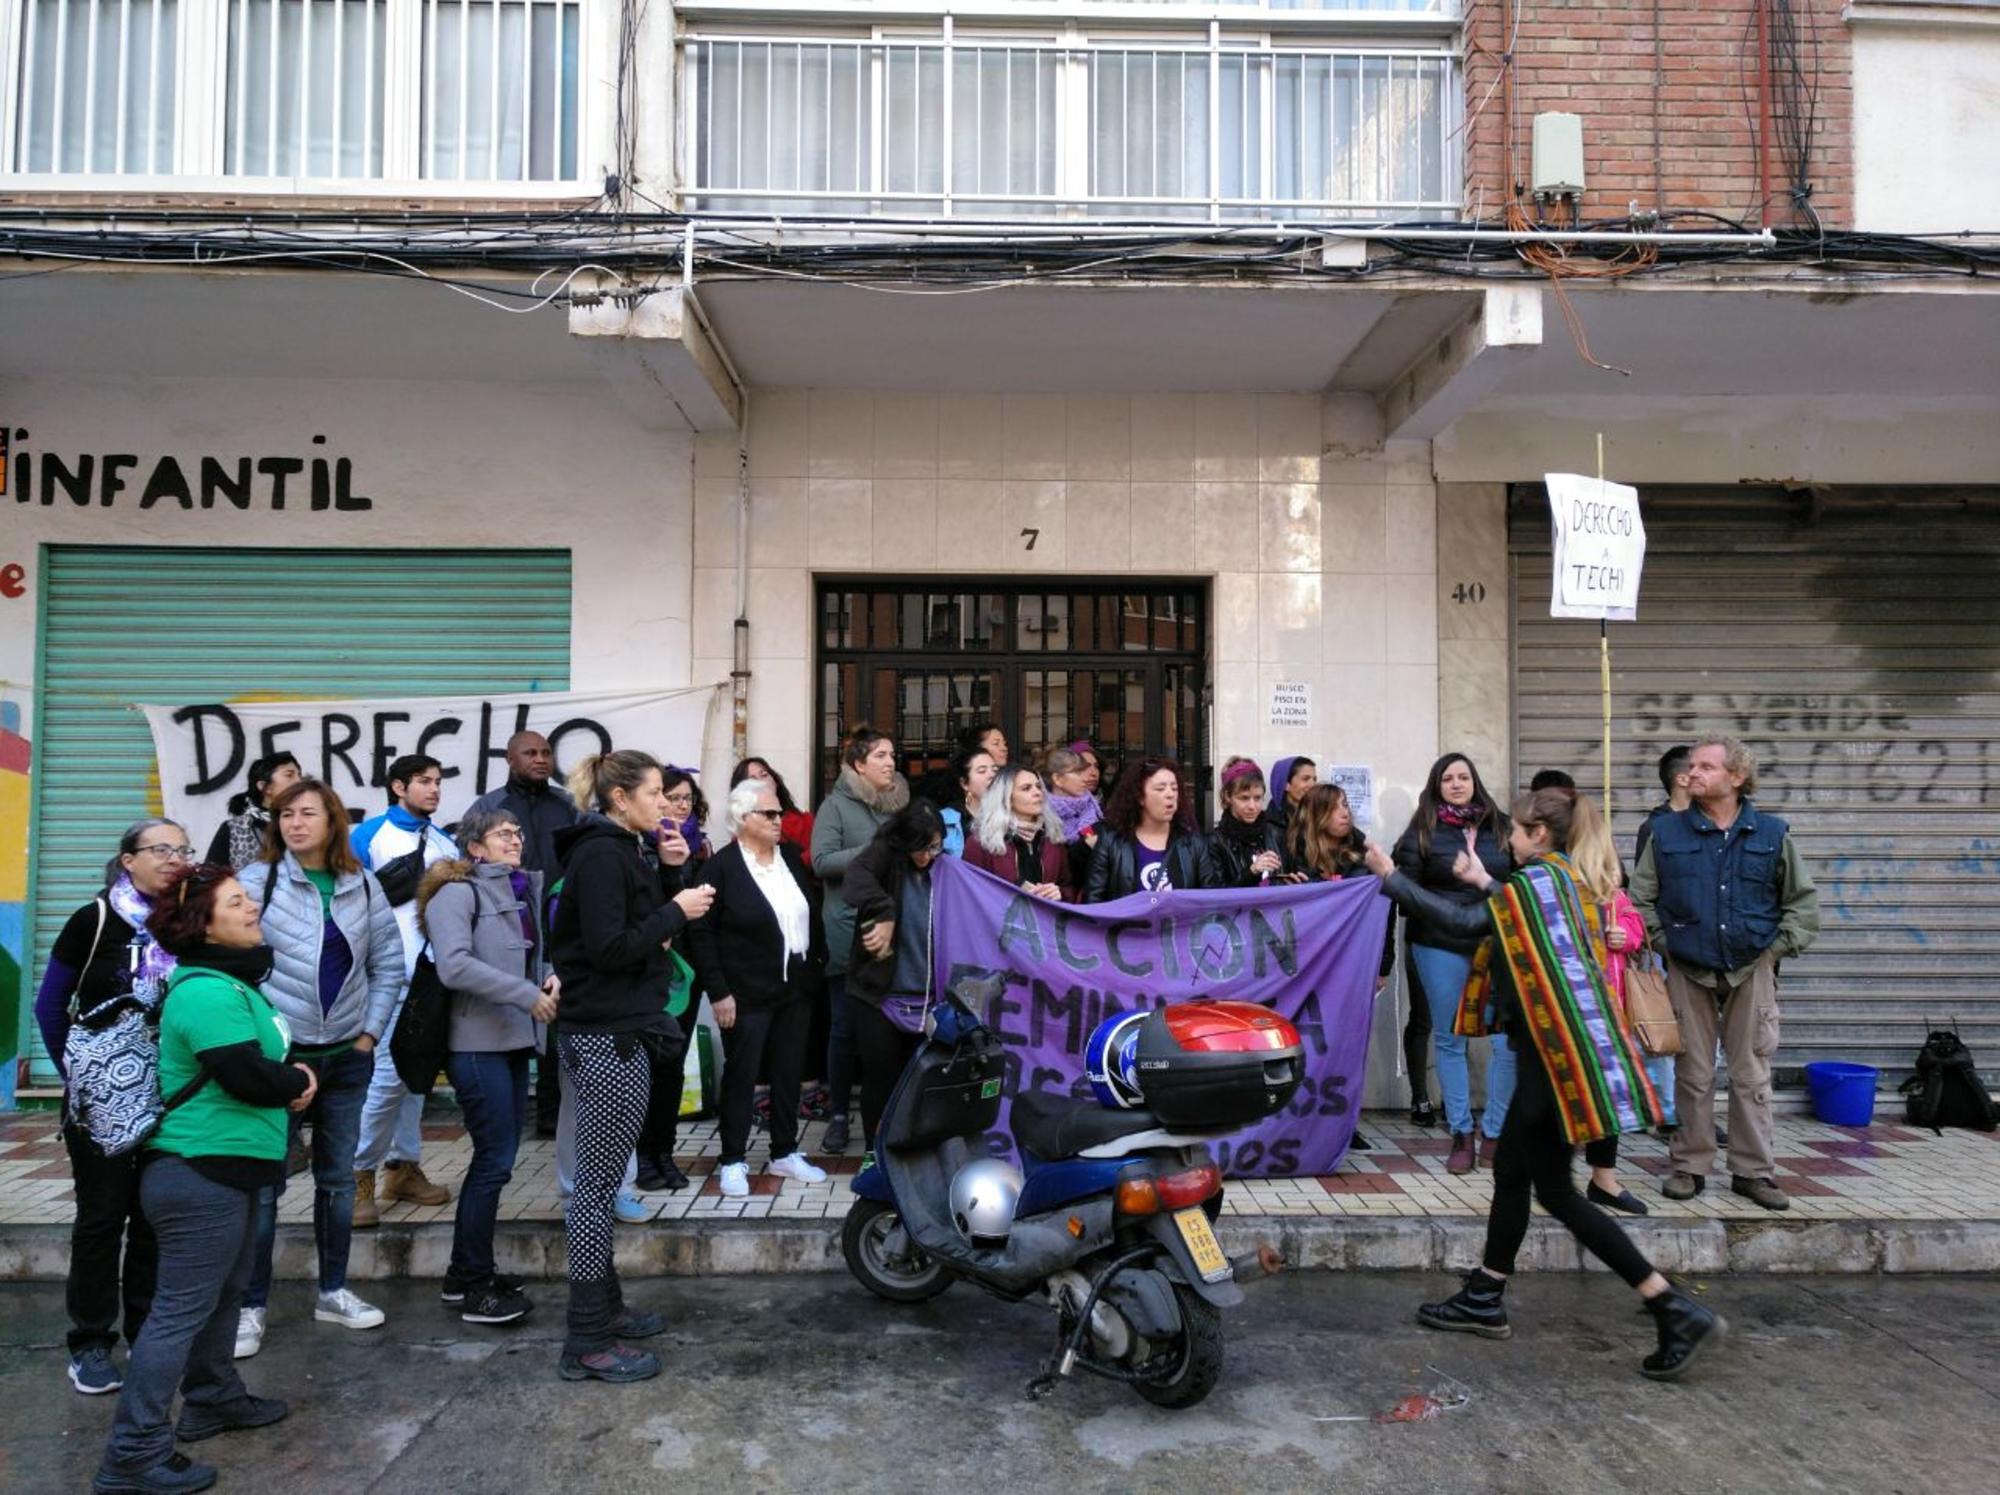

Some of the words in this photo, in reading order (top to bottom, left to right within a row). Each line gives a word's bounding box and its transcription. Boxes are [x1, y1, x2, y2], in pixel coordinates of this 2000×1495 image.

[1572, 499, 1632, 537] DERECHO
[1020, 527, 1040, 551] 7
[1451, 582, 1486, 605] 40
[172, 701, 613, 796] DERECHO
